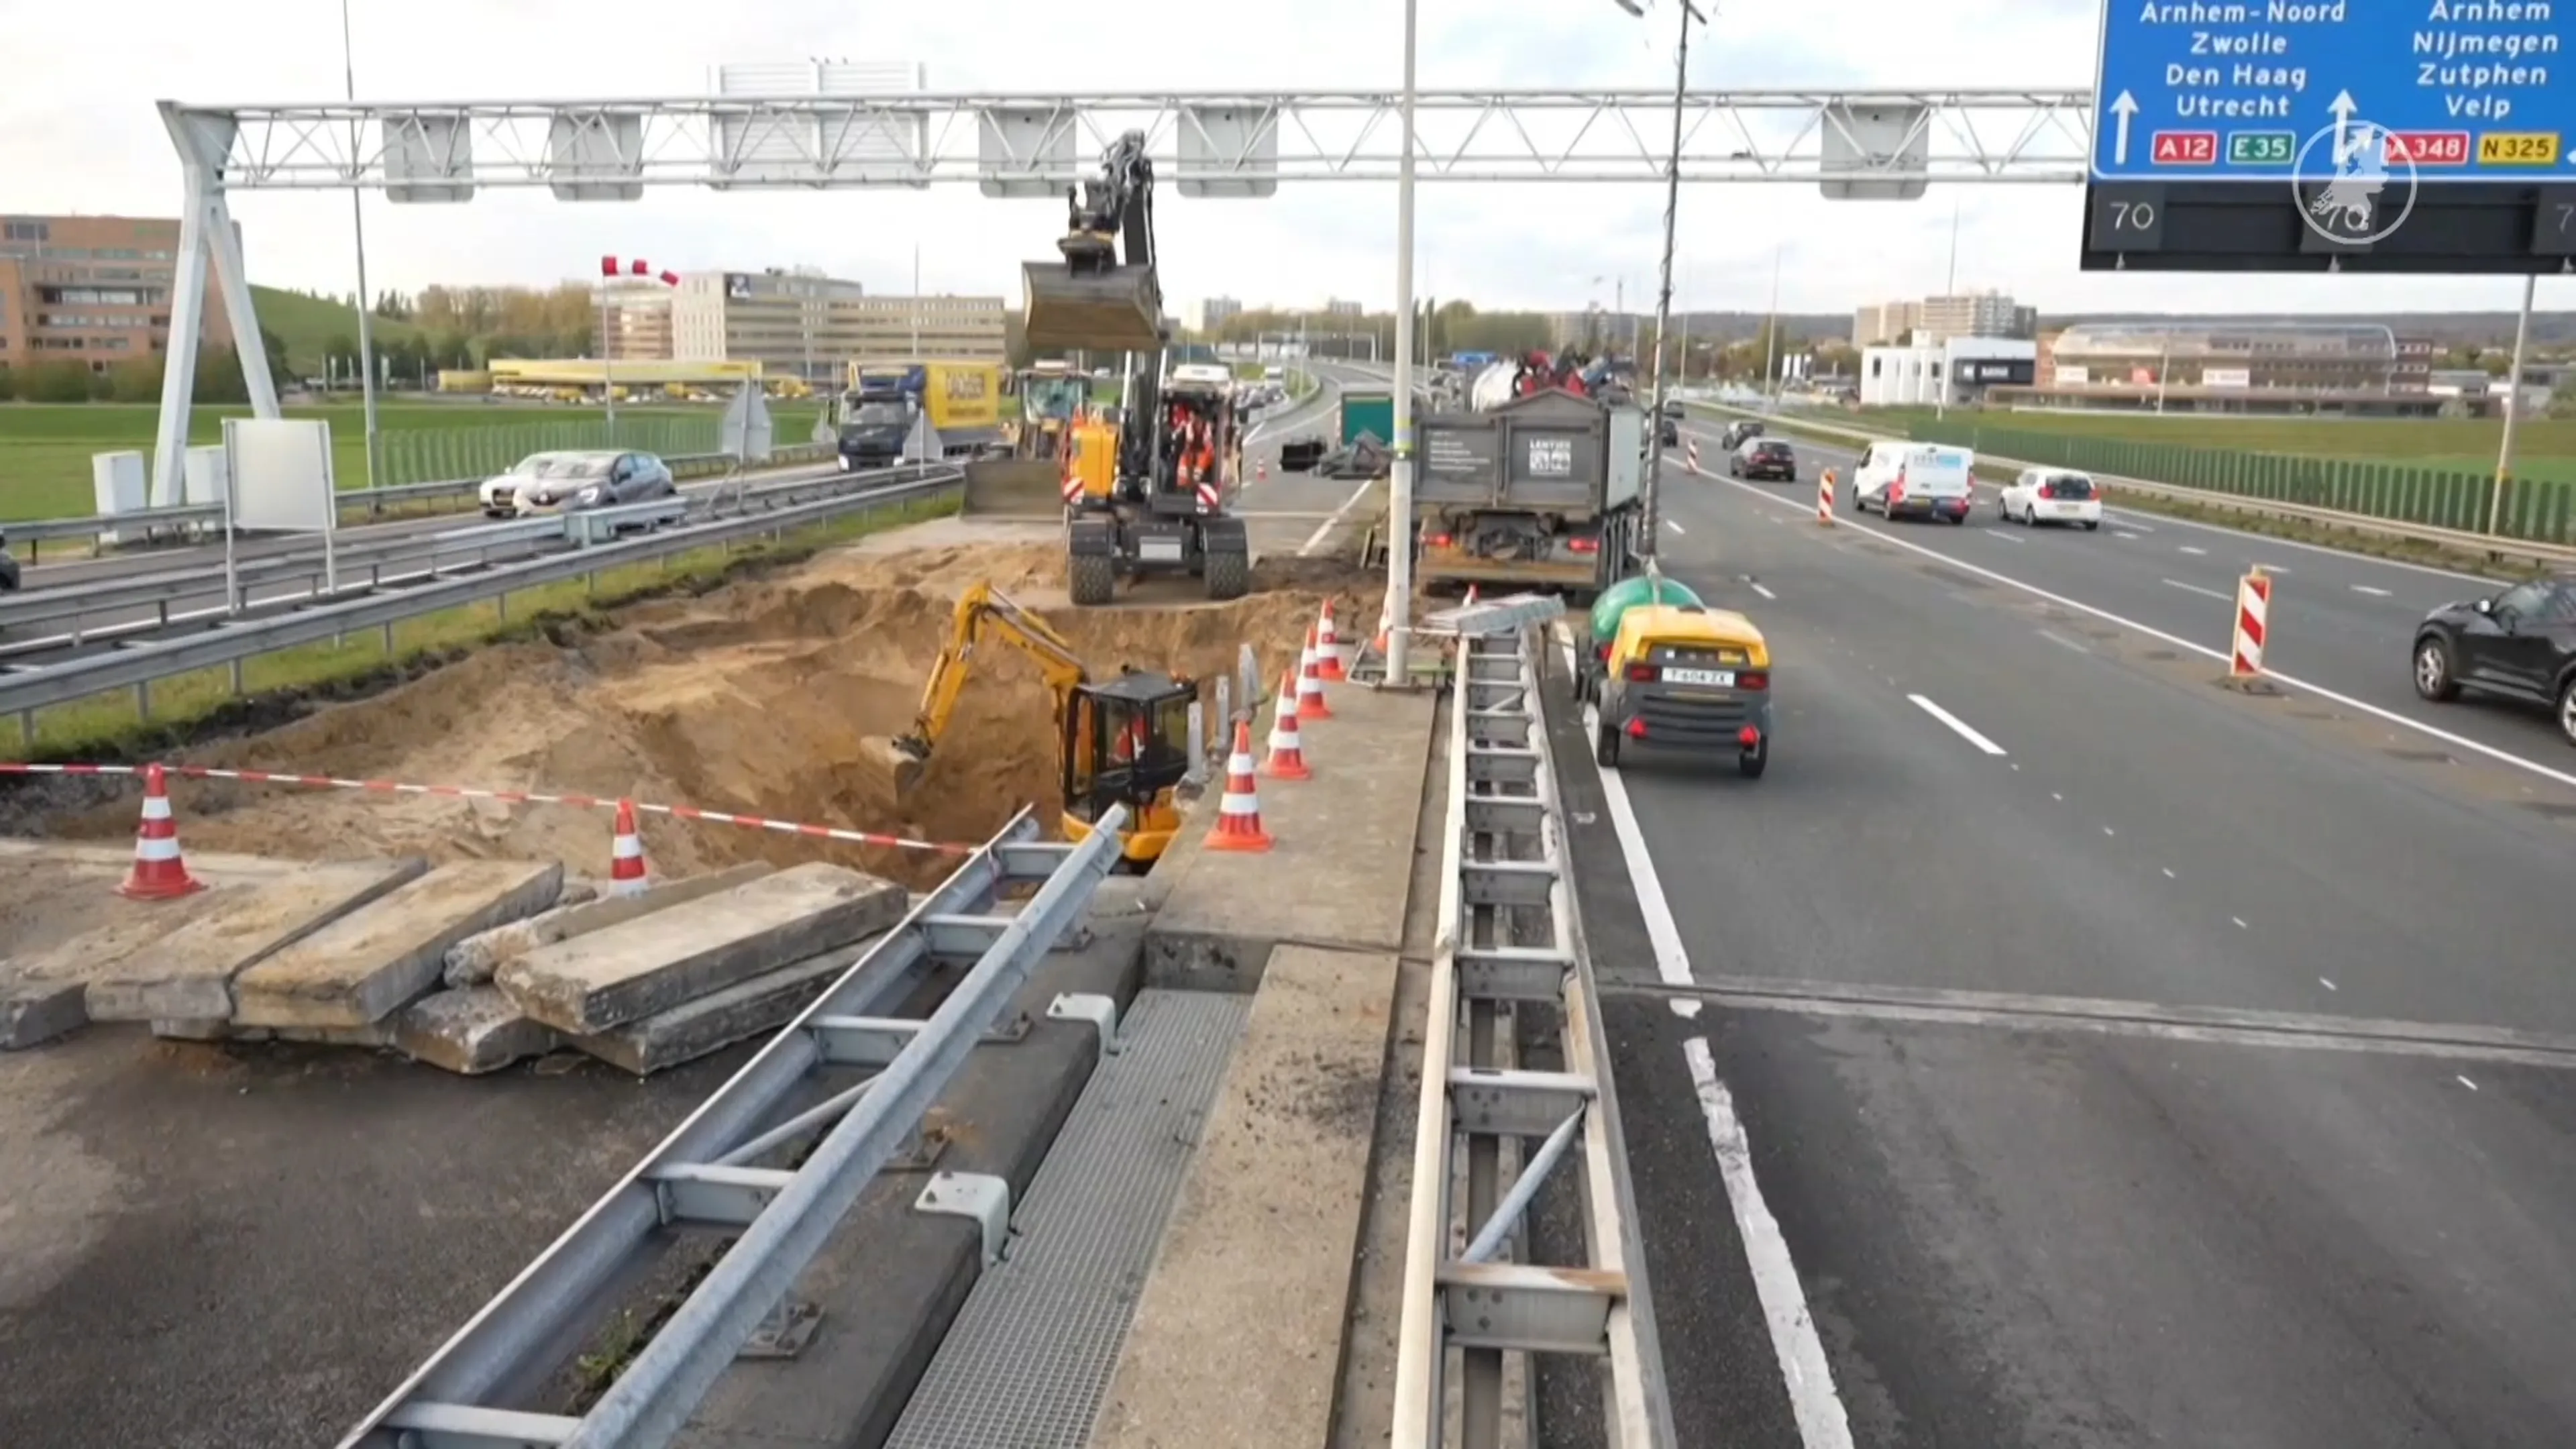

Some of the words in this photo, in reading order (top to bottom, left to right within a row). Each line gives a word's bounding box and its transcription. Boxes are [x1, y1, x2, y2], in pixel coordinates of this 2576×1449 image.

[2428, 0, 2551, 21] Arnhem
[2190, 31, 2288, 54] Zwolle
[2414, 30, 2559, 60] Nijmegen
[2165, 63, 2220, 87] Den
[2233, 63, 2307, 93] Haag
[2416, 62, 2547, 89] Zutphen
[2176, 95, 2289, 117] Utrecht
[2445, 94, 2512, 120] Velp
[2108, 201, 2154, 230] 70
